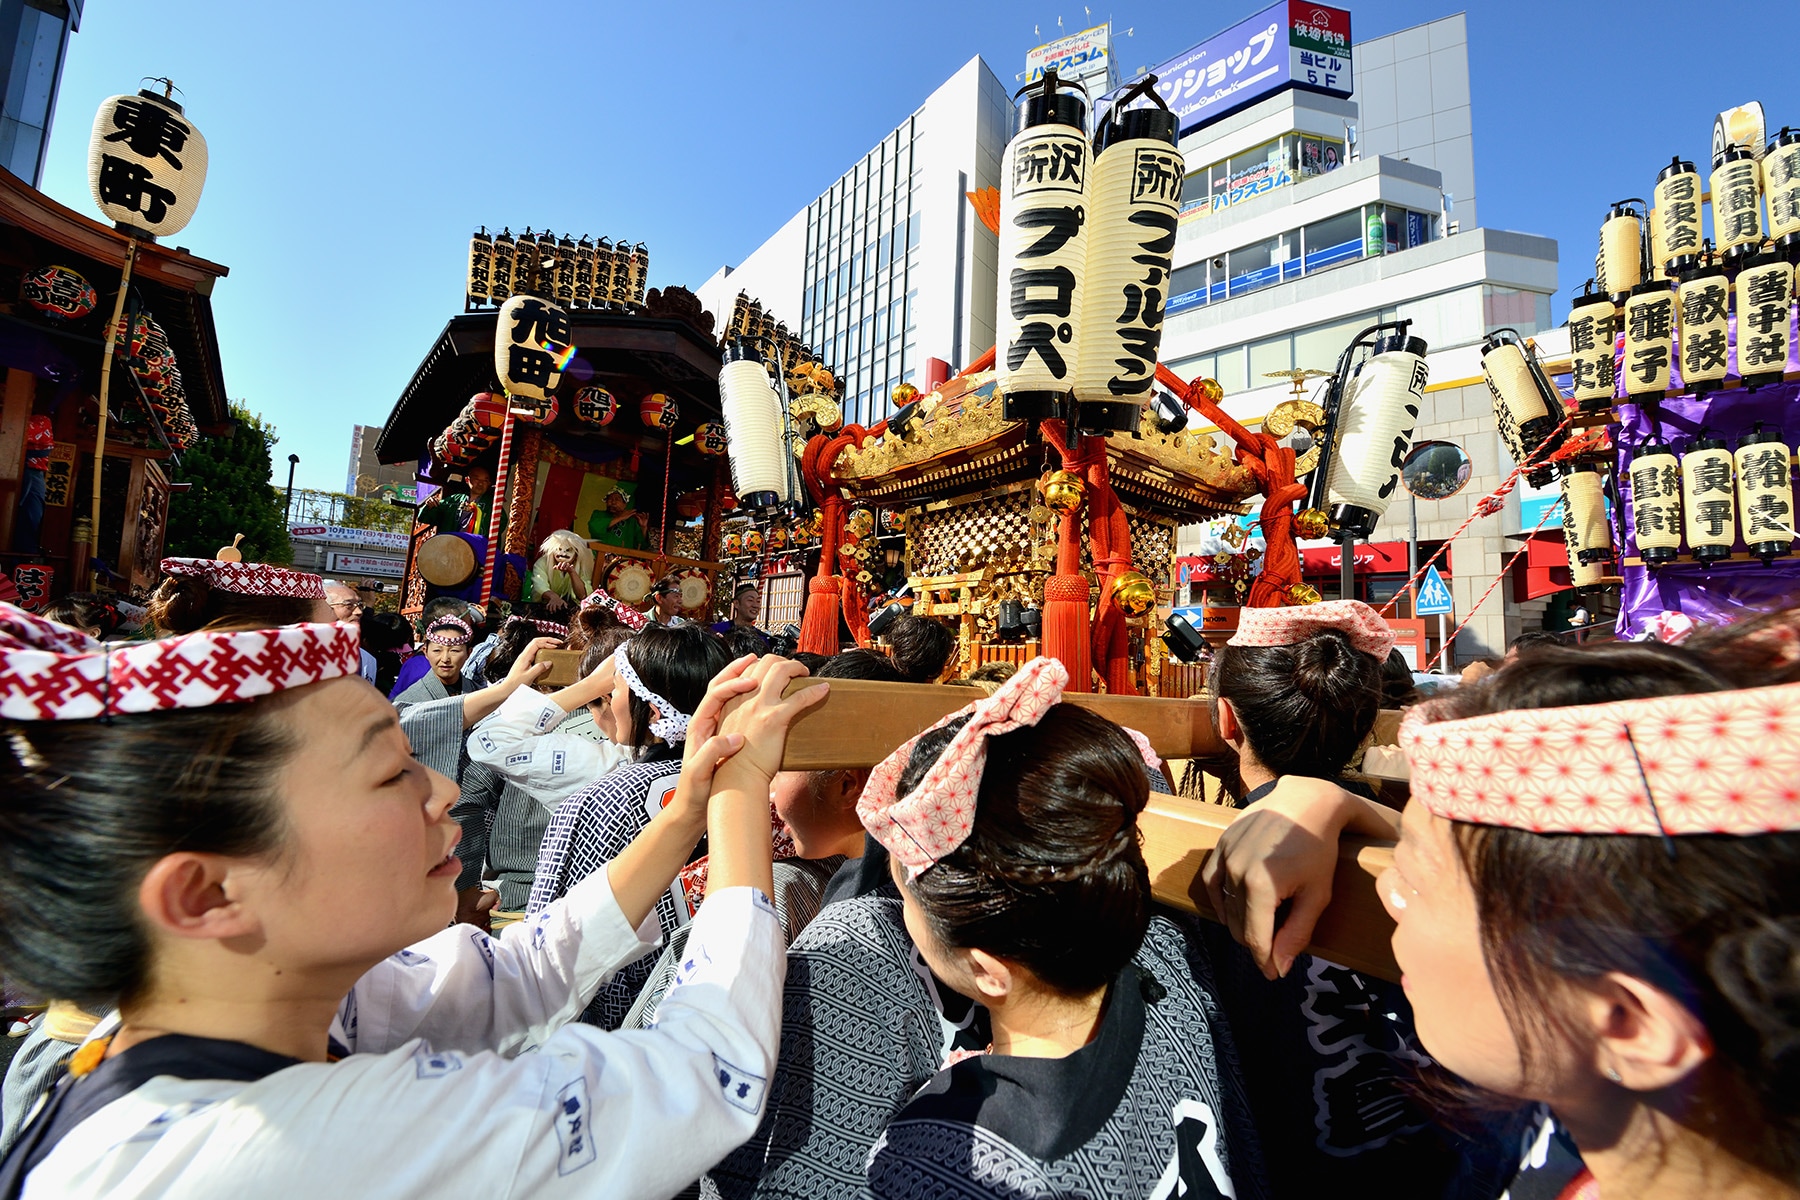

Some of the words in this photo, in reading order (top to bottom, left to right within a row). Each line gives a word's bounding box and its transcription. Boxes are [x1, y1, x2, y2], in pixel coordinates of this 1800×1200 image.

[1031, 47, 1103, 80] ハウスコム
[1294, 23, 1345, 46] 快適賃貸
[1300, 51, 1342, 72] 当ビル
[99, 99, 191, 224] 東町
[1016, 142, 1083, 186] 所沢
[1214, 170, 1291, 210] ハウスコム
[1007, 205, 1085, 380] プロペ
[508, 299, 573, 398] 旭町
[1629, 297, 1672, 384] 雅子
[1683, 284, 1728, 373] 敏枝
[579, 386, 611, 421] 旭町
[1692, 457, 1733, 537] 良平
